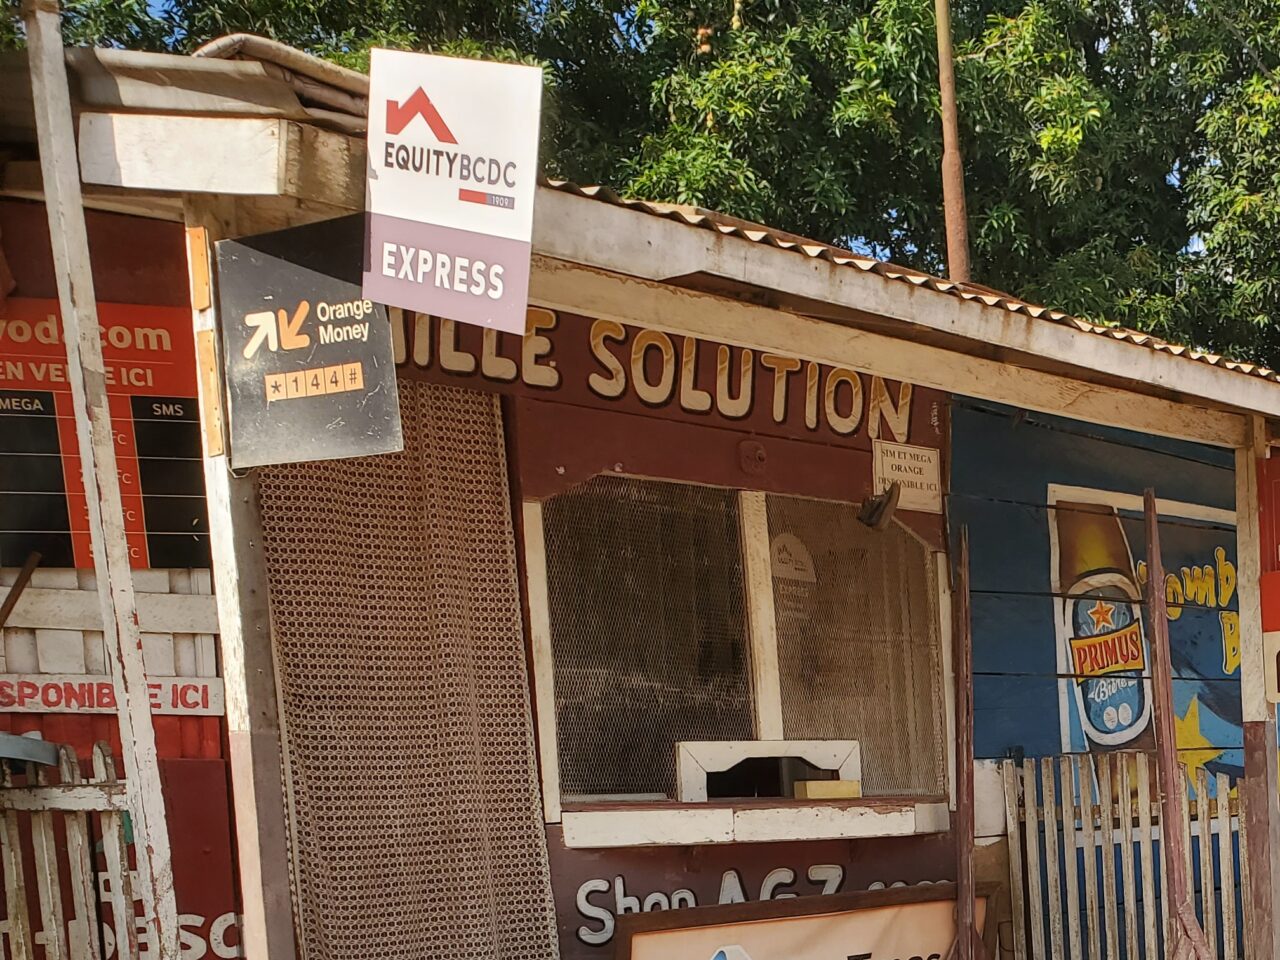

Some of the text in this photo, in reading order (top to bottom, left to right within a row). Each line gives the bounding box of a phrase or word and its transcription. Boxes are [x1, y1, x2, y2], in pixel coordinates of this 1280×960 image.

[492, 195, 509, 207] 1909
[382, 242, 504, 300] EXPRESS
[317, 299, 373, 321] Orange
[319, 322, 369, 345] Money
[121, 367, 153, 387] ICI
[388, 306, 914, 443] ILLE SOLUTION
[0, 398, 184, 416] MEGA SMS
[881, 449, 932, 464] SIM ET MEGA
[890, 463, 925, 476] ORANGE
[926, 483, 937, 492] ICI
[1075, 630, 1141, 675] PRIMUS
[0, 680, 209, 709] SPONIBE ICI
